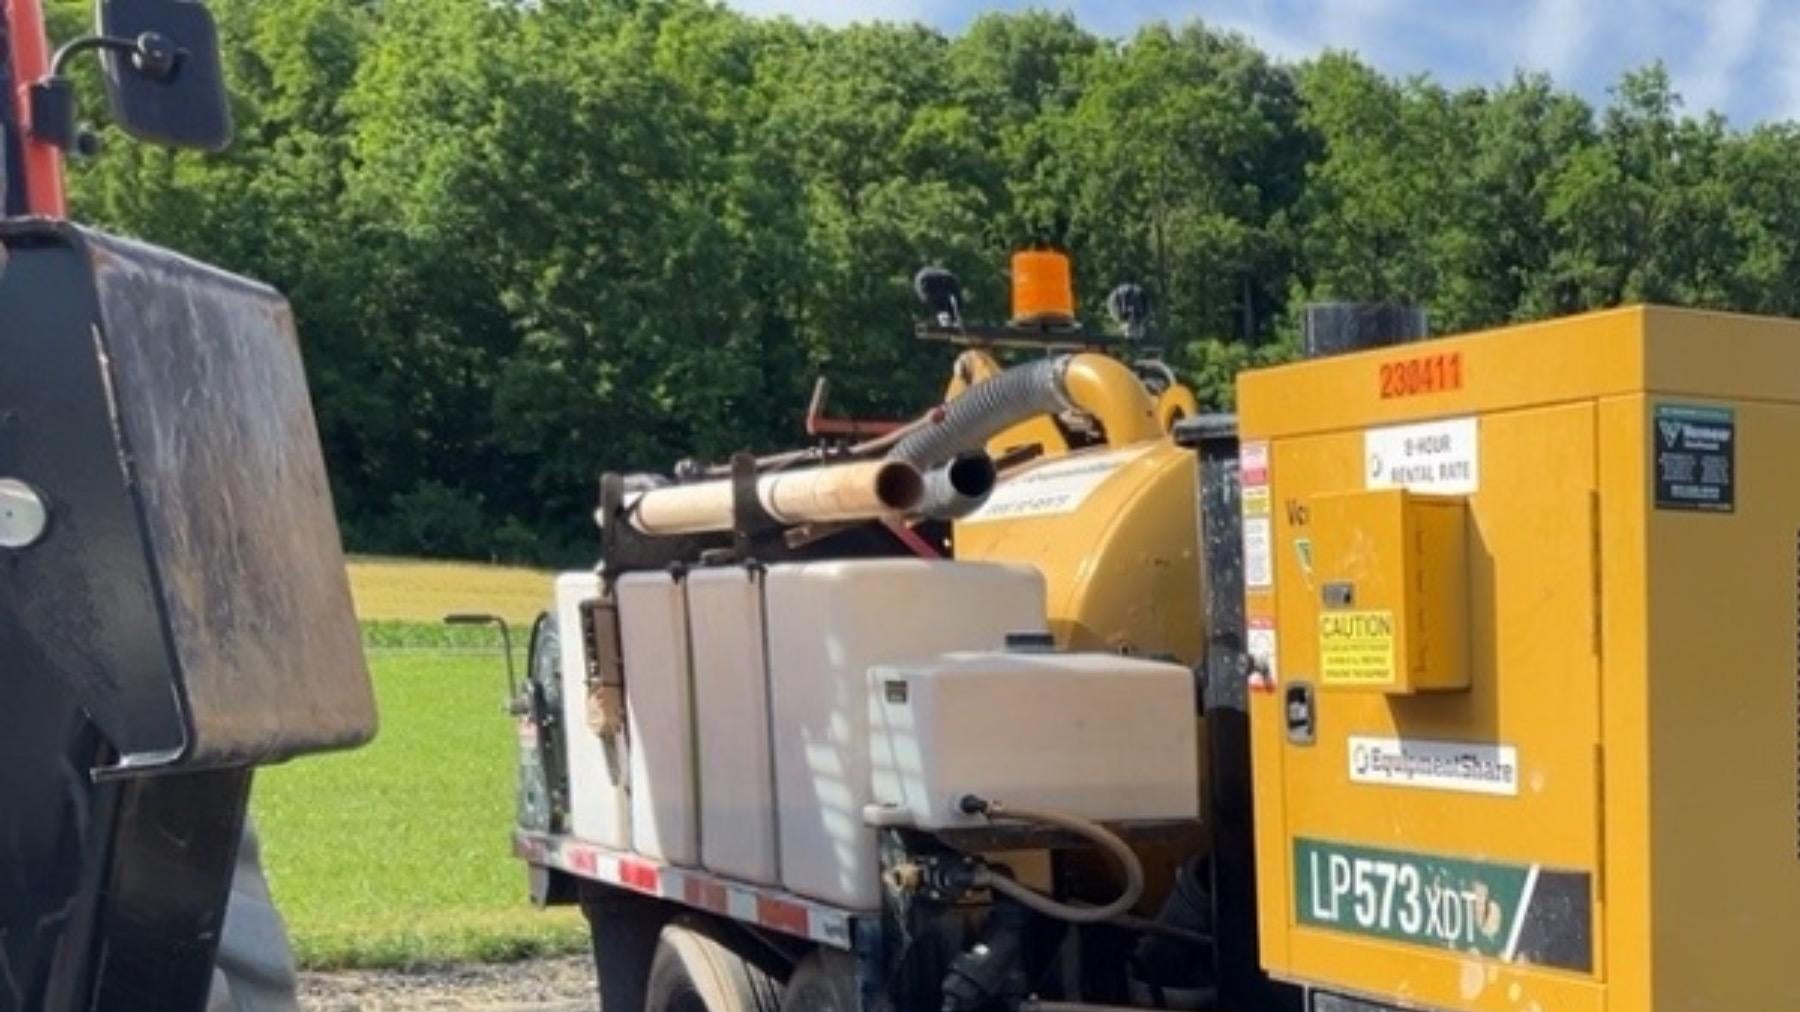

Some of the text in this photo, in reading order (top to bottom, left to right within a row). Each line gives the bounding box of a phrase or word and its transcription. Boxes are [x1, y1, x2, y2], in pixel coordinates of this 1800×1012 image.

[1380, 352, 1460, 399] 230411
[1439, 461, 1469, 481] RATE
[1321, 614, 1391, 639] CAUTION
[1371, 746, 1513, 784] EquipmentShare
